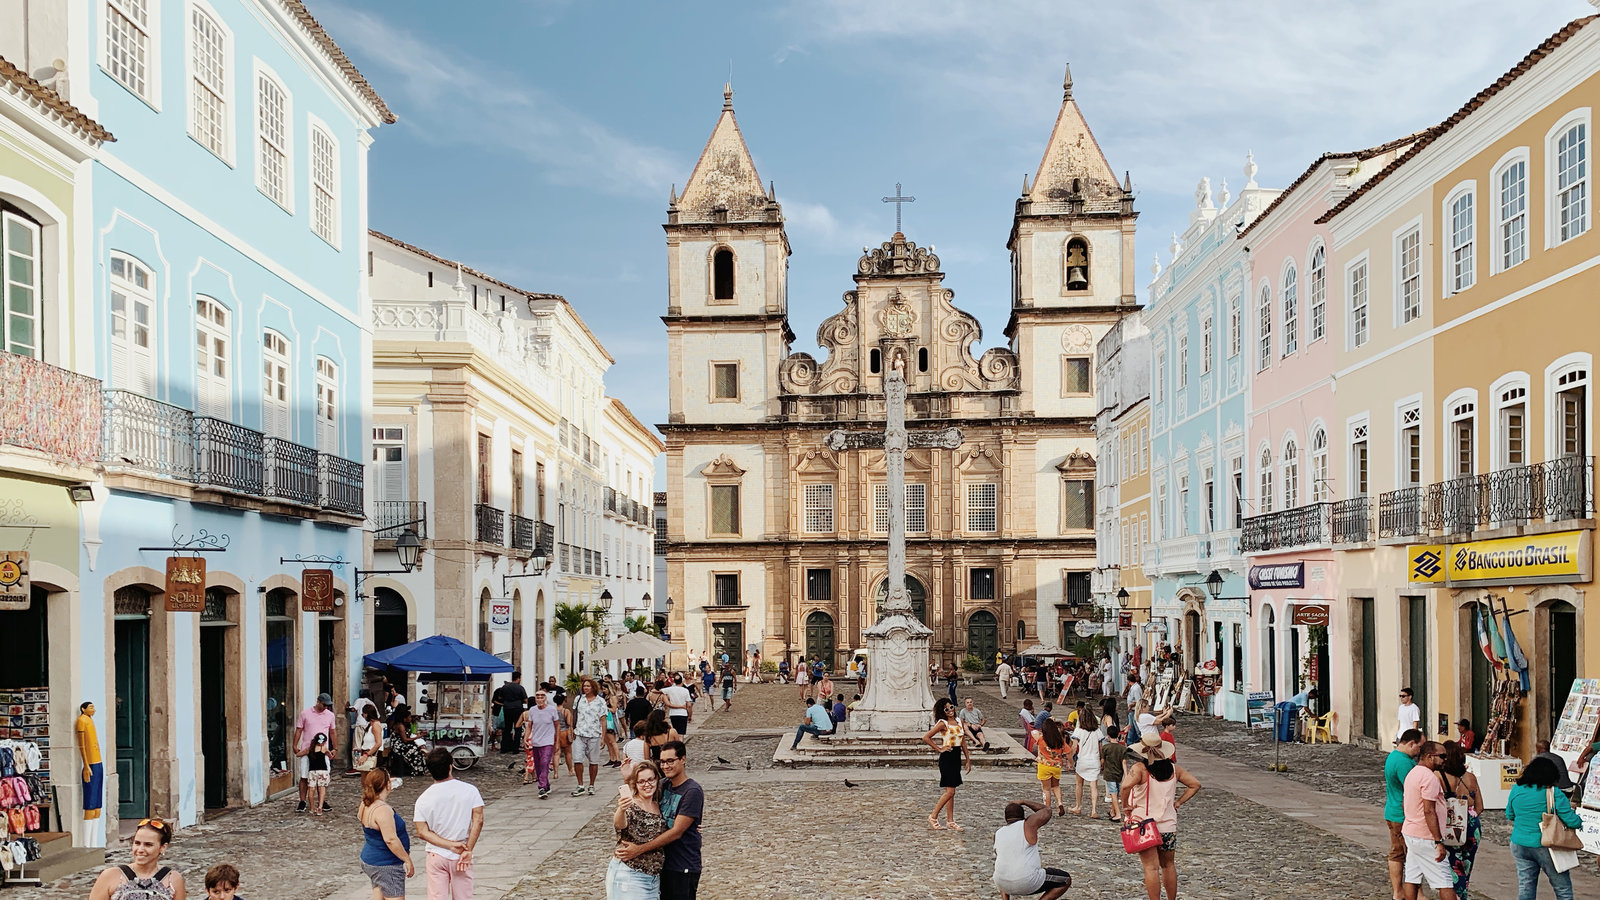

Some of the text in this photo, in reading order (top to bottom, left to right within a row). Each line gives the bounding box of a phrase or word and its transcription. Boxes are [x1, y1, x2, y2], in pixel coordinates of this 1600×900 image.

[1468, 545, 1570, 570] BANCO DO BRASIL
